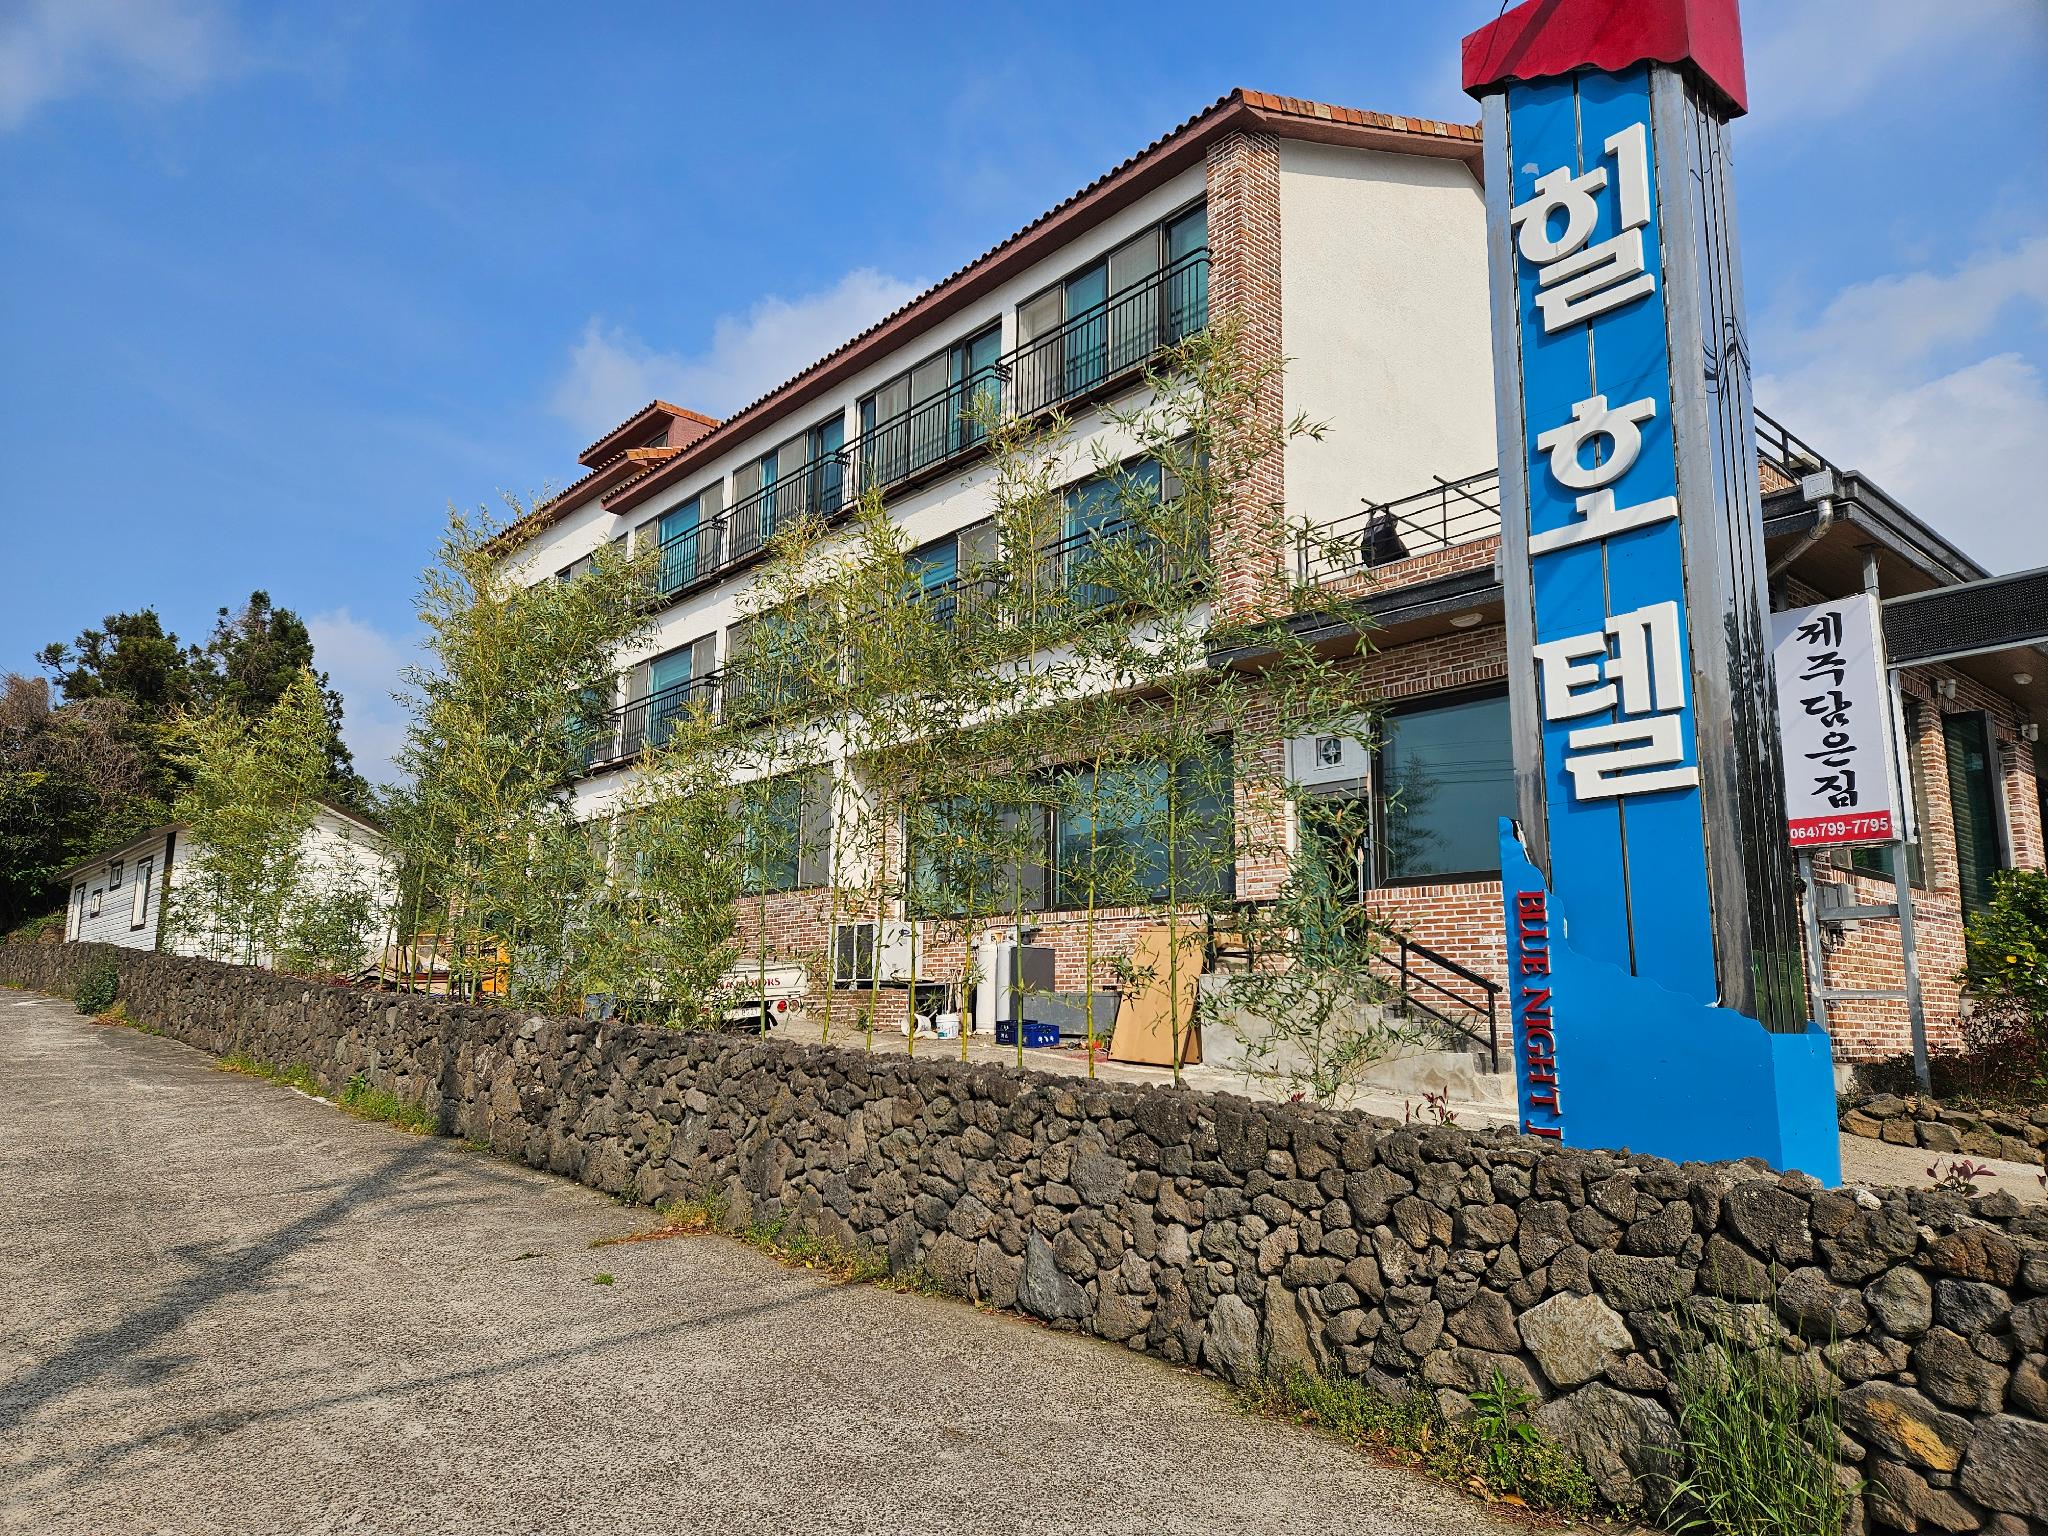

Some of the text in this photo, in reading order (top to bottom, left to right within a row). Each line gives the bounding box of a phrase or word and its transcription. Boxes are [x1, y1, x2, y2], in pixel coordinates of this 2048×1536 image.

[1790, 817, 1889, 839] 064)799-7795
[1517, 888, 1551, 975] BLUE
[1522, 986, 1562, 1115] NIGHT
